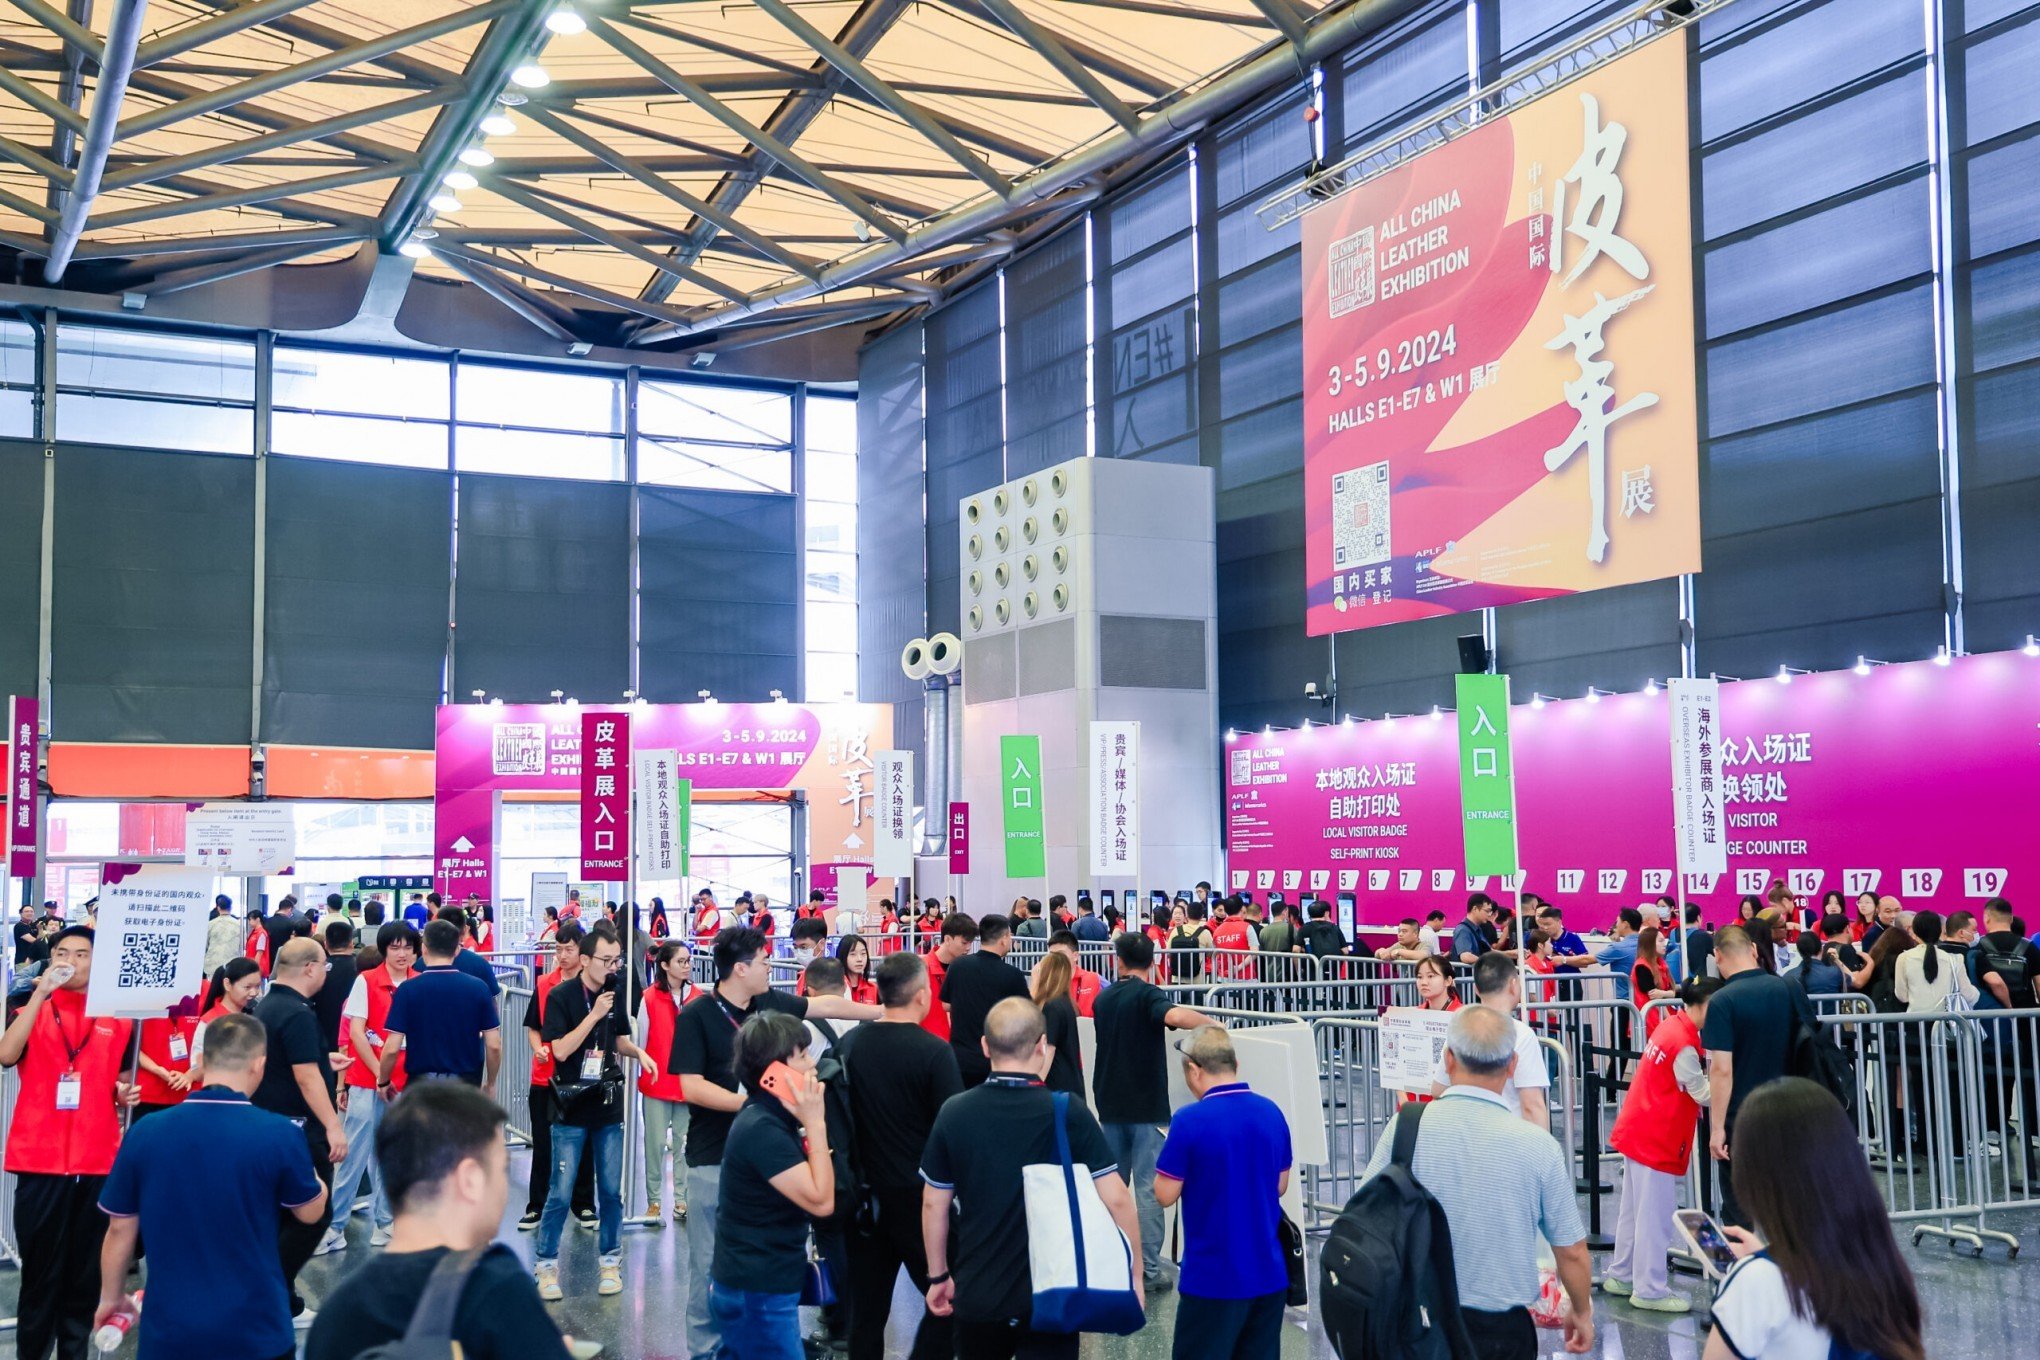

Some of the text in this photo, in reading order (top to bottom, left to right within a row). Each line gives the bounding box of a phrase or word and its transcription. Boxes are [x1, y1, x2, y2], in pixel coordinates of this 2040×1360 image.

[1380, 188, 1462, 243] ALL CHINA
[1528, 160, 1545, 270] 中国国际
[1381, 225, 1449, 271] LEATHER
[1381, 246, 1470, 300] EXHIBITION
[1543, 92, 1660, 562] 皮革
[1328, 323, 1457, 396] 3-5.9.2024
[1328, 360, 1500, 434] HALLS E1-E7 & W1 展厅
[1619, 464, 1657, 519] 展
[1414, 546, 1442, 558] APLF
[1333, 566, 1393, 595] 国内买家
[1373, 589, 1392, 606] 登记
[551, 723, 575, 735] ALL
[722, 729, 807, 743] 3-5.9.2024
[1682, 706, 1690, 748] OVERSEAS
[551, 739, 582, 750] LEAT
[1470, 704, 1497, 777] 入口
[1720, 732, 1812, 766] 众入场证
[699, 752, 739, 765] E1-E7
[742, 752, 752, 765] &
[755, 752, 775, 765] W1
[780, 752, 807, 766] 展厅
[1253, 747, 1285, 759] ALL CHINA
[18, 722, 32, 828] 贵宾通道
[1252, 761, 1280, 772] LEATHER
[1684, 750, 1692, 792] EXHIBITOR
[1011, 756, 1032, 809] 入口
[1252, 773, 1288, 785] EXHIBITION
[1315, 762, 1416, 791] 本地观众入场证
[1697, 708, 1717, 844] 海外参展商入场证
[594, 720, 616, 851] 皮革展入口
[1723, 771, 1789, 804] 换领处
[892, 761, 904, 839] 观众入场证换领
[1115, 733, 1127, 861] 贵宾/媒体/协会入场证
[657, 760, 671, 870] 本地观众入场证自助打印
[1330, 793, 1401, 820] 自助打印处
[1466, 811, 1510, 820] ENTRANCE
[1686, 795, 1694, 822] BADGE
[954, 812, 965, 840] 出口
[1728, 813, 1778, 828] VISITOR
[1007, 831, 1041, 839] ENTRANCE
[1323, 824, 1408, 838] LOCAL VISITOR BADGE
[1100, 836, 1108, 867] COUNTER
[1687, 824, 1695, 862] COUNTER
[1746, 840, 1808, 855] COUNTER
[1330, 847, 1400, 859] SELF-PRINT KIOSK
[463, 858, 485, 867] Halls
[584, 860, 624, 868] ENTRANCE
[474, 869, 487, 878] W1
[1233, 873, 1239, 886] 1
[1260, 873, 1266, 886] 2
[1284, 873, 1291, 886] 3
[1313, 873, 1320, 886] 4
[1340, 873, 1347, 886] 5
[1370, 873, 1377, 887] 6
[1401, 873, 1408, 887] 7
[1434, 873, 1441, 887] 8
[1560, 873, 1575, 889] 11
[1600, 873, 1618, 889] 12
[1644, 873, 1662, 889] 13
[1690, 873, 1709, 890] 14
[1742, 872, 1763, 891] 15
[1794, 872, 1816, 891] 16
[1849, 872, 1873, 892] 17
[1909, 872, 1933, 892] 18
[1971, 872, 1998, 892] 19
[128, 904, 186, 913] 请扫描此二维码
[1794, 898, 1807, 907] 18
[1216, 933, 1241, 944] STAFF
[1644, 1038, 1667, 1065] AFF
